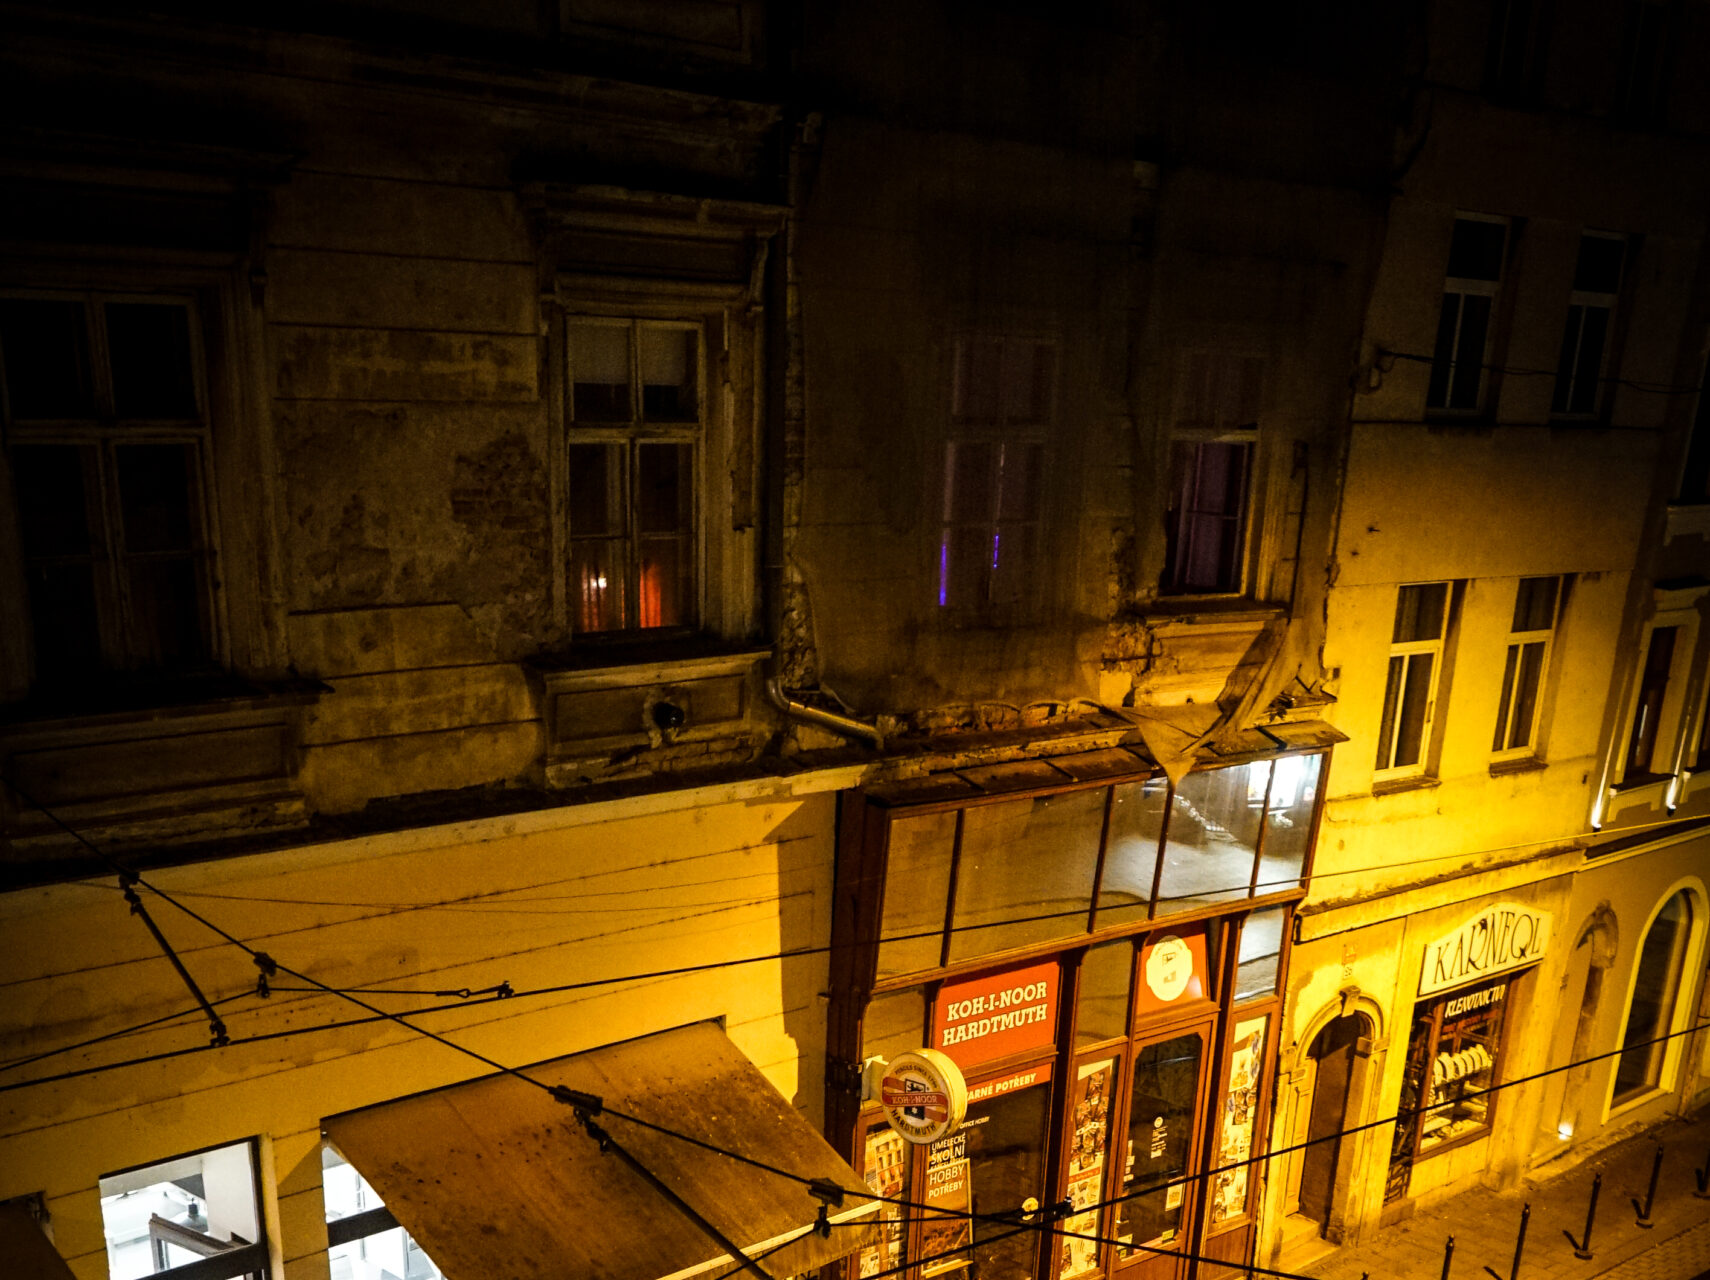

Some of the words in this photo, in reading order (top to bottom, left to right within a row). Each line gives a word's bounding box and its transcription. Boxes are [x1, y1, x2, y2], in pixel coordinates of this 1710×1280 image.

[947, 981, 1047, 1021] KOH-I-NOOR
[942, 1003, 1048, 1046] HARDTMUTH
[966, 1082, 993, 1101] ARNÉ
[891, 1108, 937, 1136] HARDTMUTH
[929, 1164, 965, 1186] HOBBY
